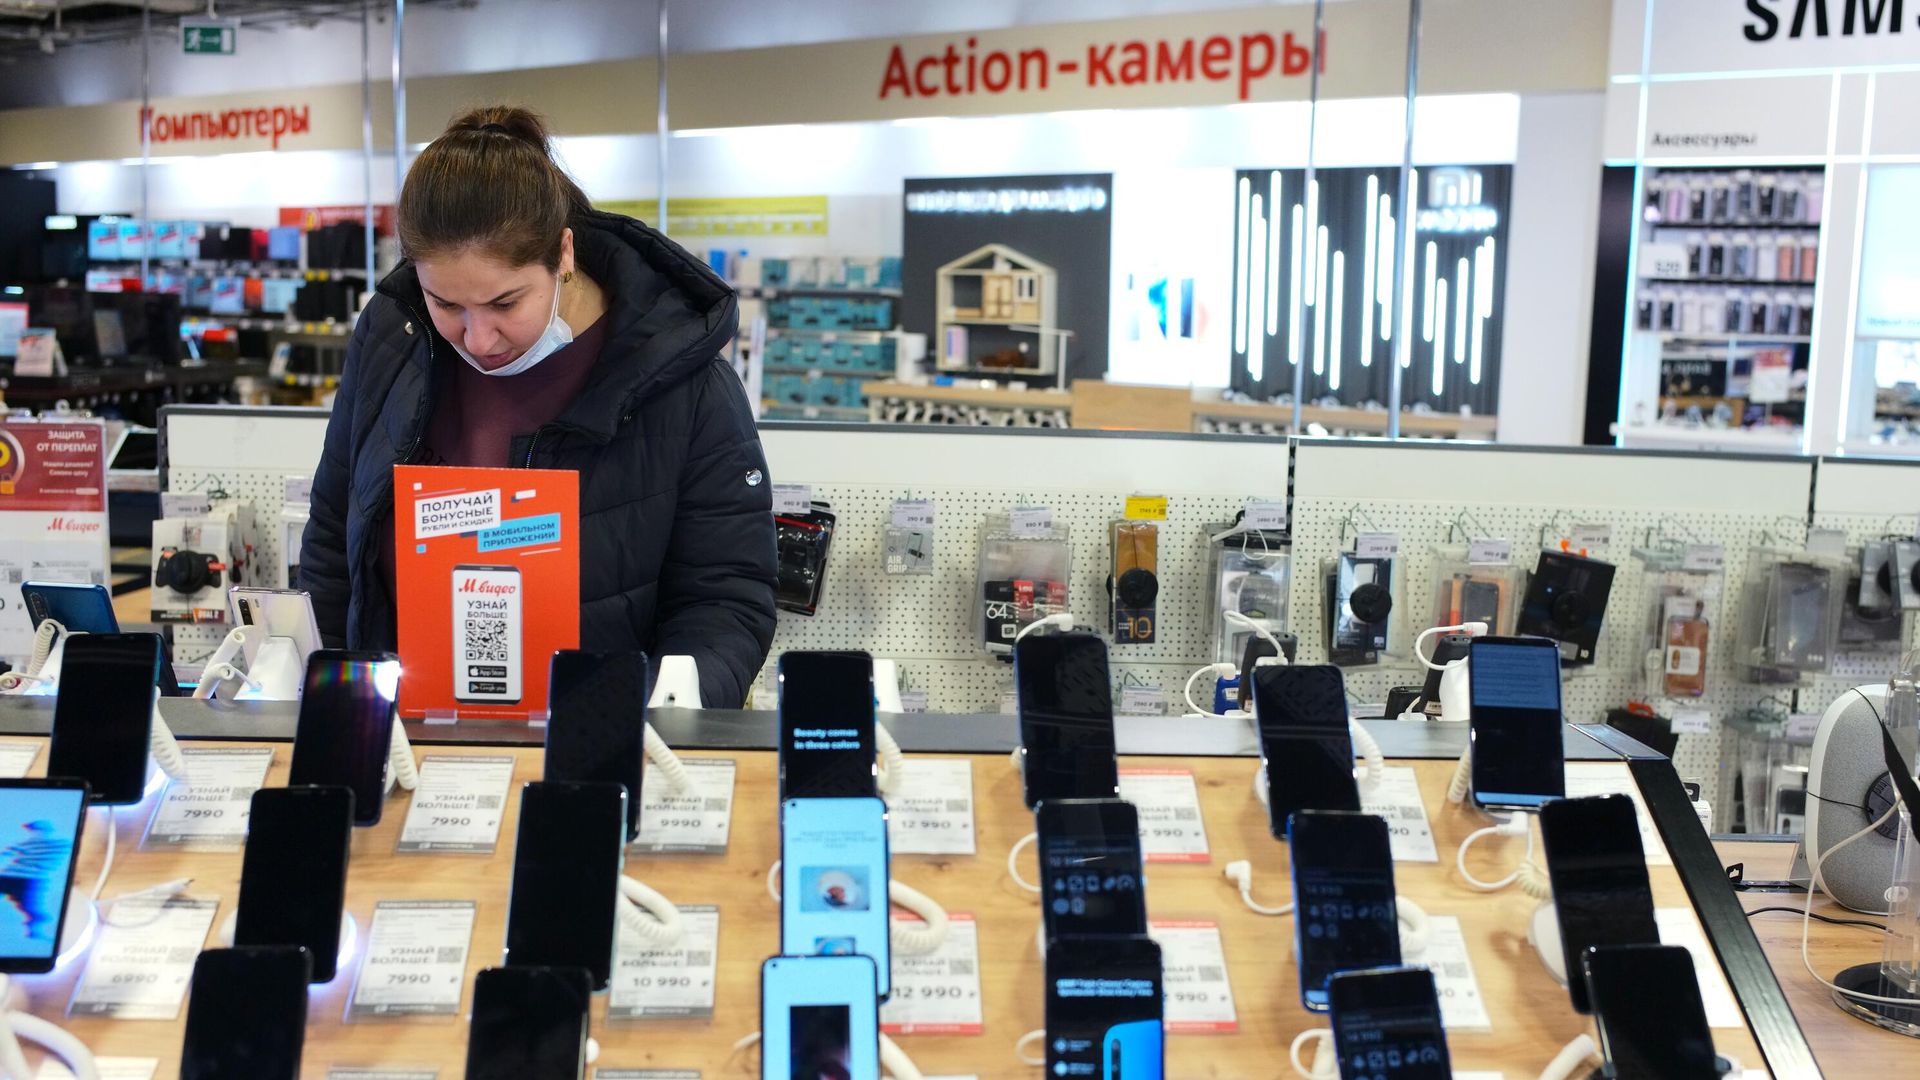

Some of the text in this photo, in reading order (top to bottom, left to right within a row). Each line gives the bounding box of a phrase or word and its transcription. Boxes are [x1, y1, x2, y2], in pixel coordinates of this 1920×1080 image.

[1743, 0, 1920, 43] SAM
[879, 30, 1327, 101] Action-камеры
[139, 104, 310, 150] Компьютеры
[48, 431, 86, 440] ЗАЩИТА
[37, 443, 98, 452] ОТ ПЕРЕПЛАТ
[421, 492, 494, 513] ПОЛУЧАЙ
[422, 507, 494, 525] БОНУСНЫЕ
[422, 523, 451, 532] РУБЛИ
[459, 517, 494, 527] СКИДКИ
[491, 523, 556, 537] МОБИЛЬНОМ
[483, 532, 556, 548] ПРИЛОЖЕНИИ
[888, 556, 901, 564] AIR
[888, 564, 907, 573] GRIP
[467, 600, 508, 609] УЗНАЙ
[986, 603, 1008, 619] 64
[1127, 616, 1152, 639] 10
[183, 809, 224, 818] 7990
[431, 817, 471, 826] 7990
[661, 819, 702, 829] 9990
[111, 973, 159, 984] 6990
[387, 974, 431, 984] 7990
[633, 977, 652, 987] 10
[656, 977, 692, 987] 990
[921, 986, 963, 998] 990
